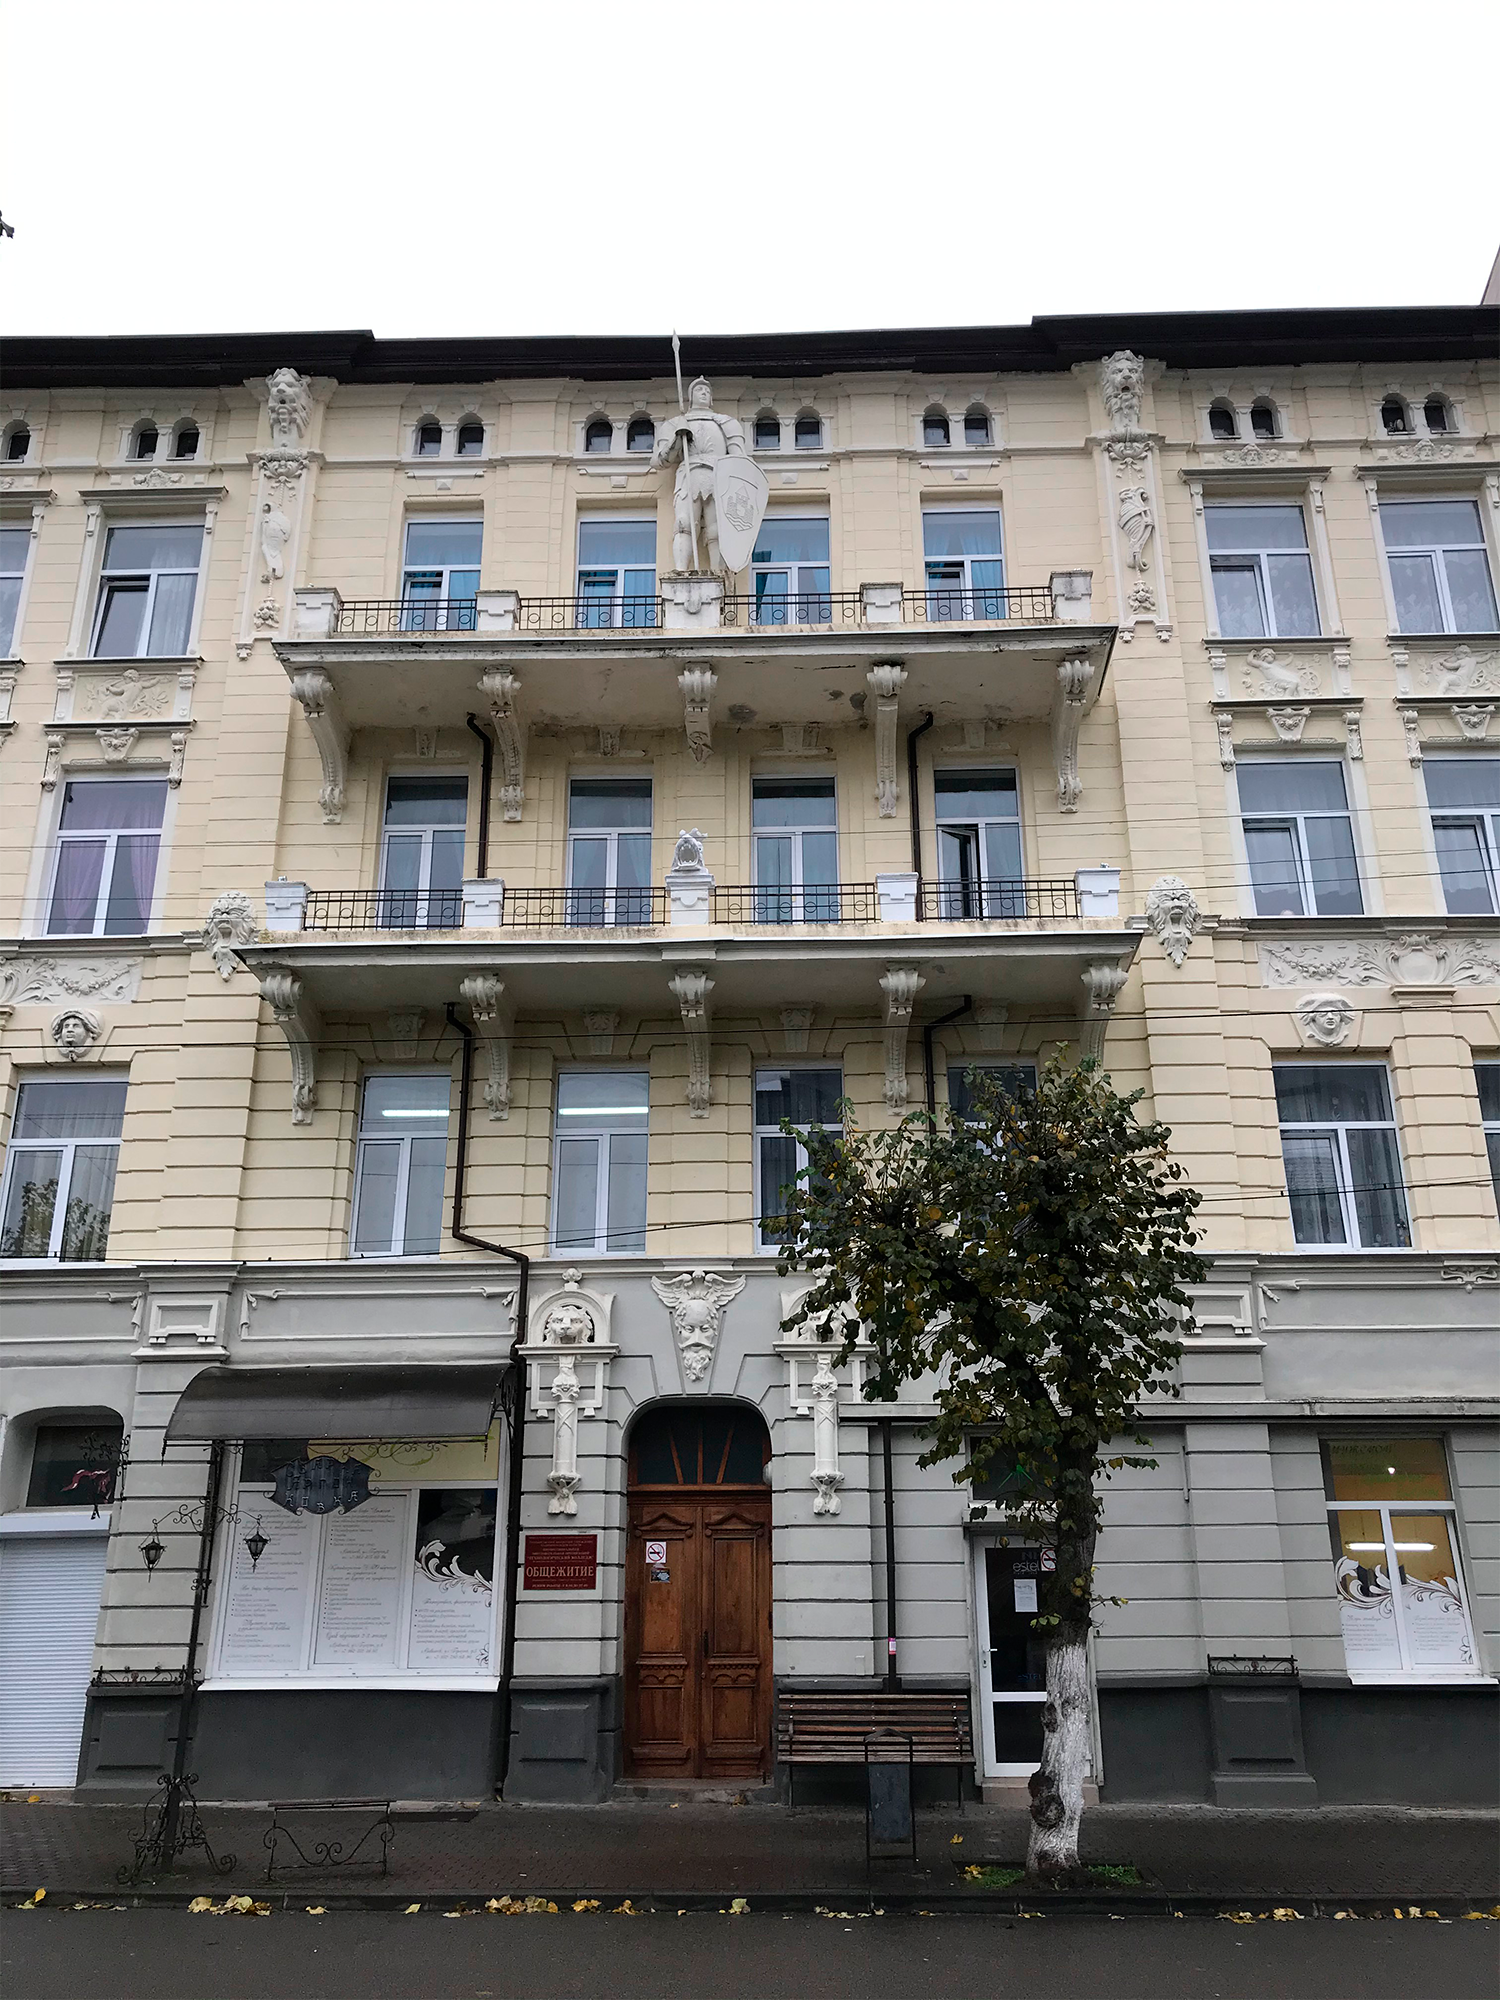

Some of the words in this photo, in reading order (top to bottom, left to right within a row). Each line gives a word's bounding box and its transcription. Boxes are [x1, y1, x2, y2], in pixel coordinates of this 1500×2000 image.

[284, 1490, 359, 1513] КОВКА
[526, 1566, 594, 1578] ОБЩЕЖИТИЕ
[1012, 1560, 1040, 1572] estel
